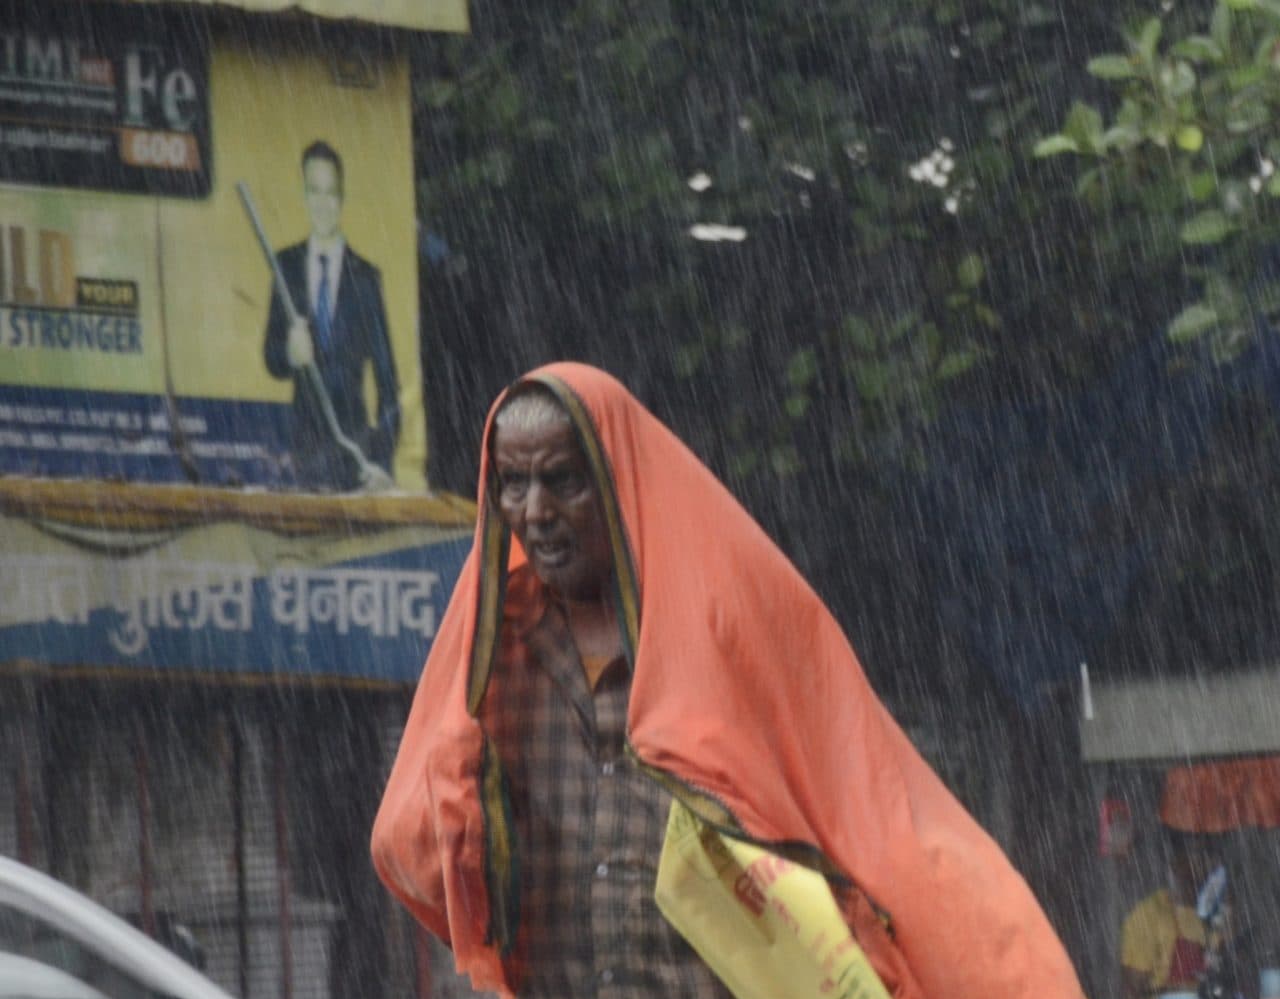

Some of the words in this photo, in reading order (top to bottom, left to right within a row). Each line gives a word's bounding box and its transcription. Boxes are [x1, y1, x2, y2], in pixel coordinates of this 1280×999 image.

[0, 224, 75, 308] LD
[9, 310, 143, 354] STRONGER
[270, 567, 440, 638] धनबाद
